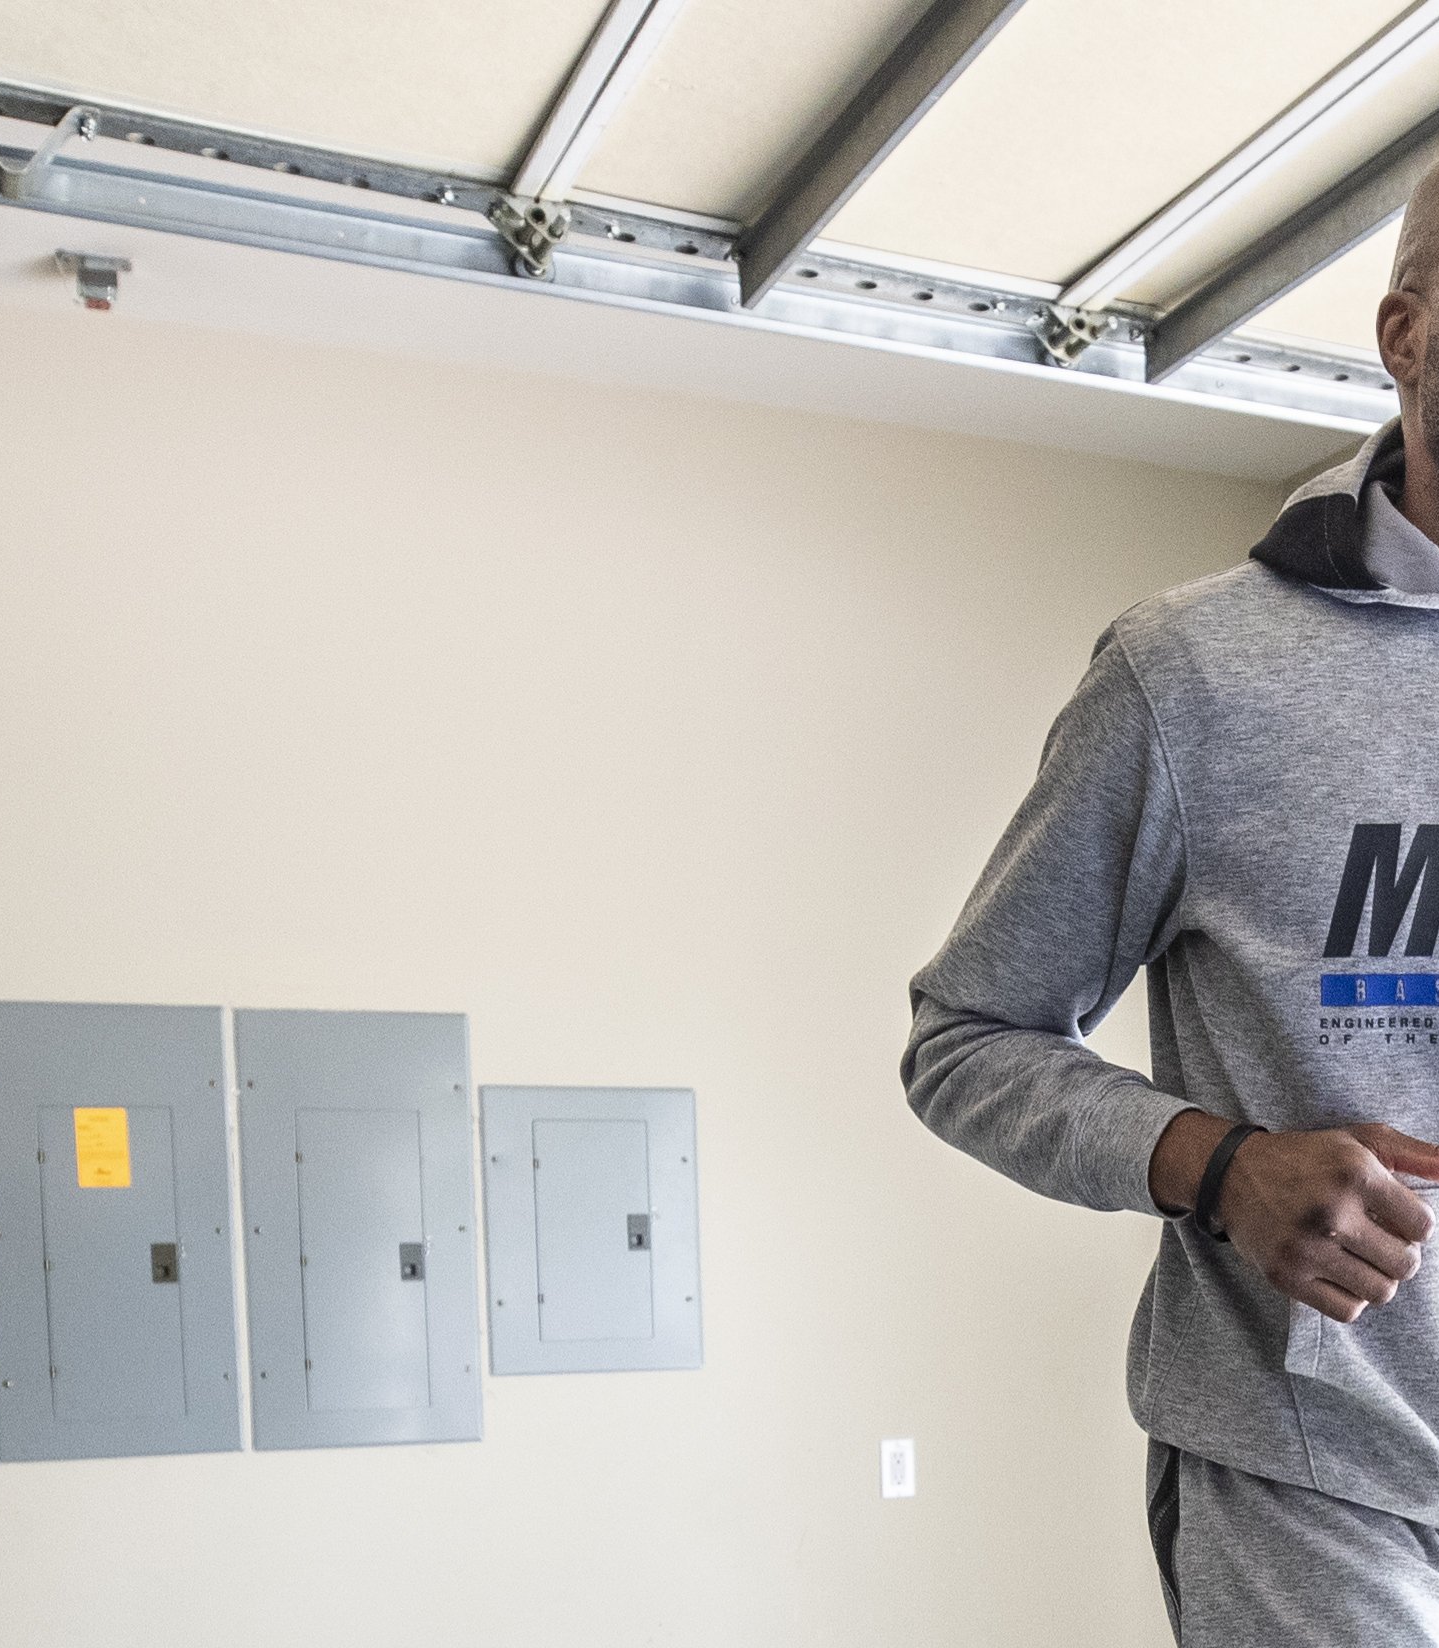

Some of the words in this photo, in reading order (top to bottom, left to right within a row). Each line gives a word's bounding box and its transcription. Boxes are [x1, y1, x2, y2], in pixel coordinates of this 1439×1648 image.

[1319, 1017, 1434, 1029] ENGINEERED
[1319, 1033, 1353, 1045] OF
[1384, 1033, 1439, 1045] THE
